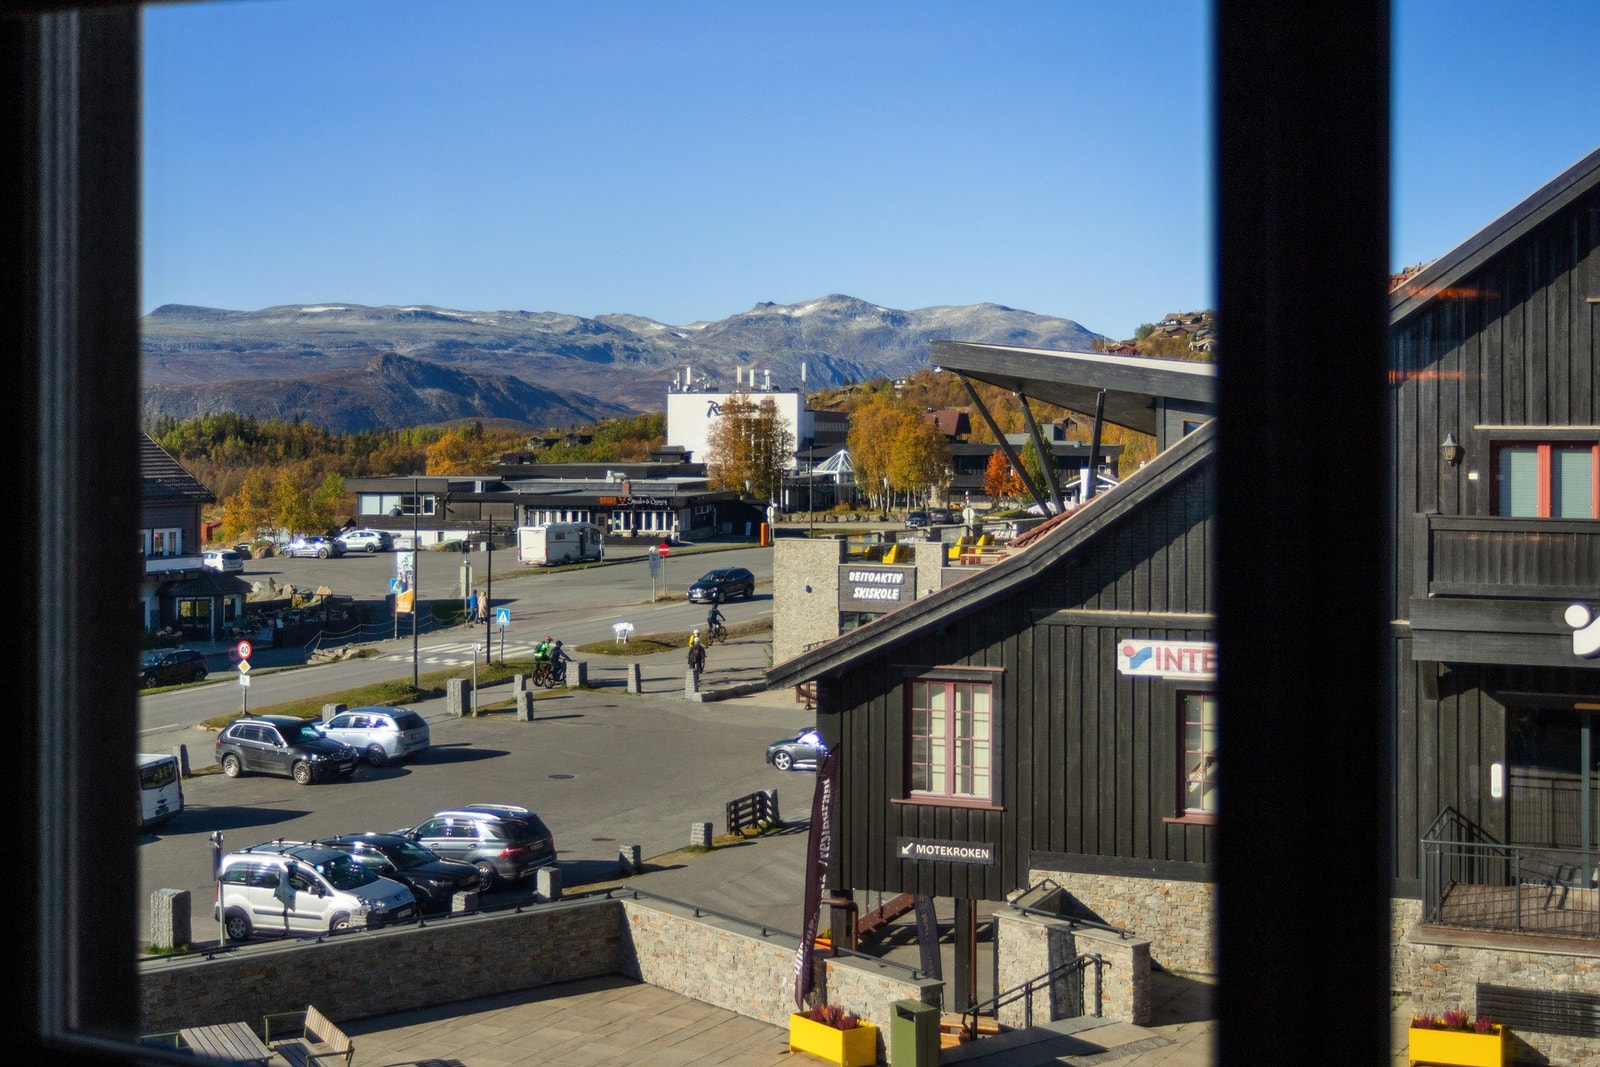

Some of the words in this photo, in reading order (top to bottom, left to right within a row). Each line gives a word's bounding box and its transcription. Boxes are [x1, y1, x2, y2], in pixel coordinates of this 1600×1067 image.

[848, 571, 903, 583] BEITOAKTIV
[853, 587, 900, 600] SKISKOLE
[241, 645, 249, 655] 40
[916, 844, 989, 859] MOTEKROKEN
